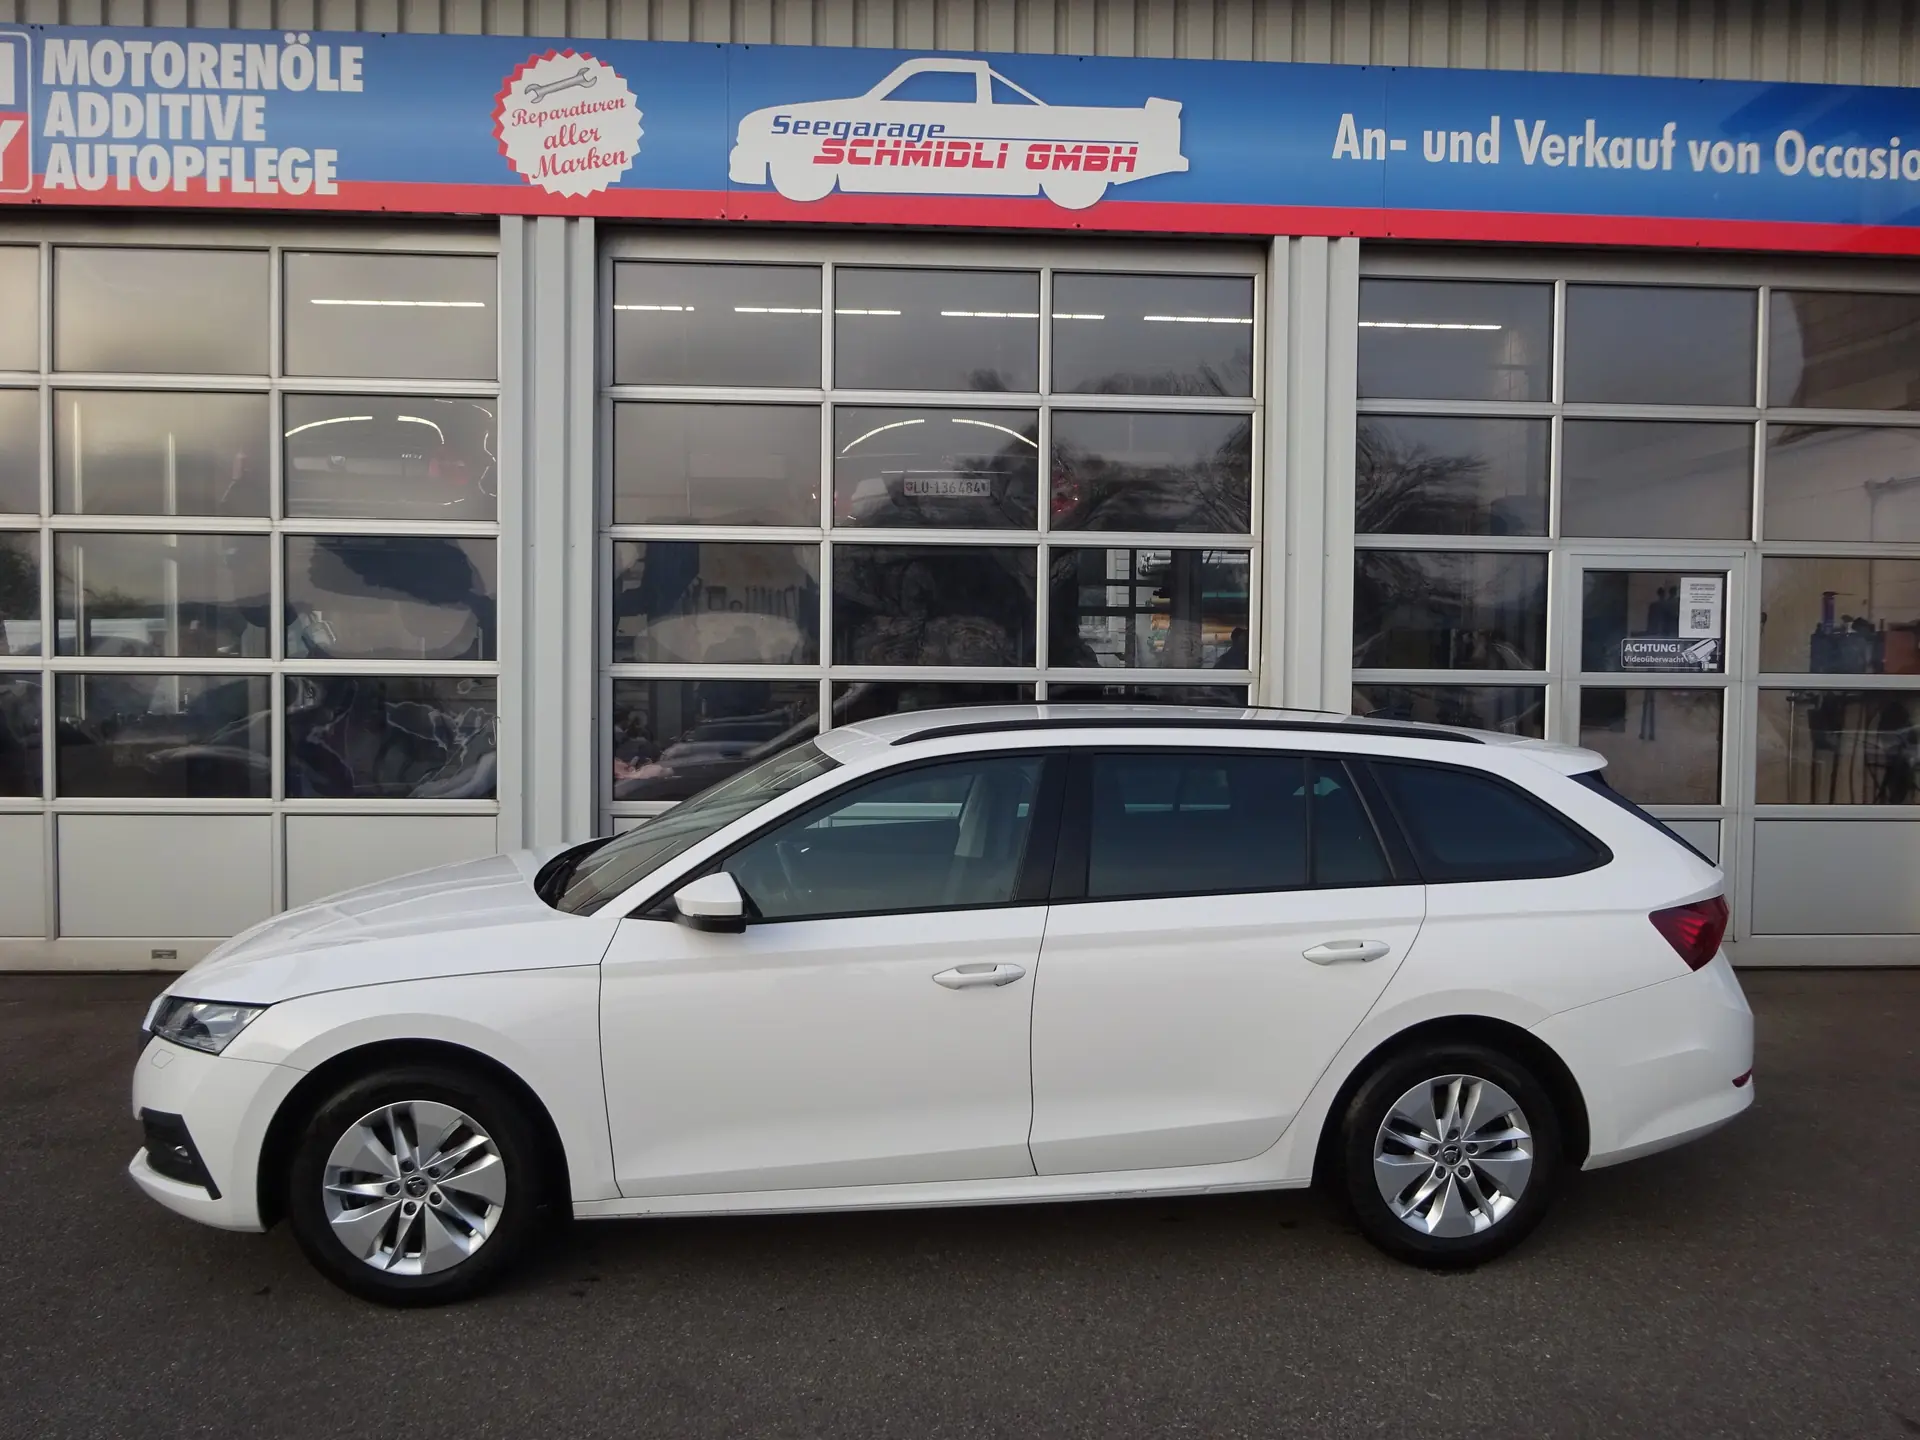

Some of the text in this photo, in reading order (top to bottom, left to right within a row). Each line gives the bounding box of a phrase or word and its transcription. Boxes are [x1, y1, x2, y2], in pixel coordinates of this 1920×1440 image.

[42, 32, 364, 92] MOTORENÖLE
[43, 91, 266, 141] ADDITIVE
[511, 98, 626, 127] Reparaturen
[771, 115, 946, 143] Seegarage
[543, 122, 602, 150] aller
[1331, 113, 1920, 181] An- und Verkauf von Occasio
[43, 143, 338, 195] AUTOPFLEGE
[531, 146, 629, 179] Marken
[813, 138, 1138, 172] SCHMIDLI GMBH
[1624, 643, 1681, 653] ACHTUNG!
[1624, 655, 1685, 663] Videoüberwacht
